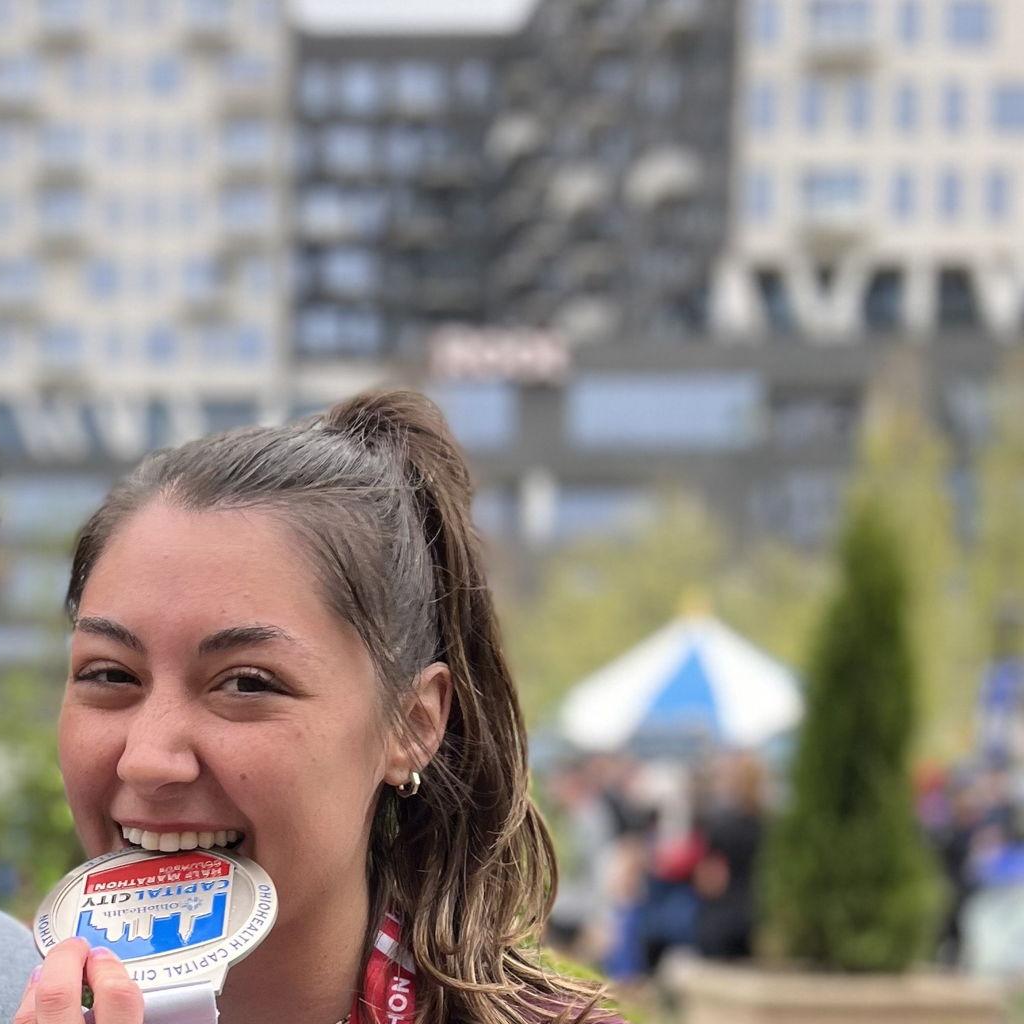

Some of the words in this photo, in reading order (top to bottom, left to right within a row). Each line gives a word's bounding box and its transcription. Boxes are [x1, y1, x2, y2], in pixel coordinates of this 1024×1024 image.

[94, 872, 181, 893] MARATHON
[184, 867, 223, 881] HALF
[103, 902, 180, 919] OhioHealth
[229, 884, 273, 951] OHIOHEALTH
[38, 913, 56, 948] ATHON
[163, 948, 229, 978] CAPITAL
[132, 969, 157, 982] CIT
